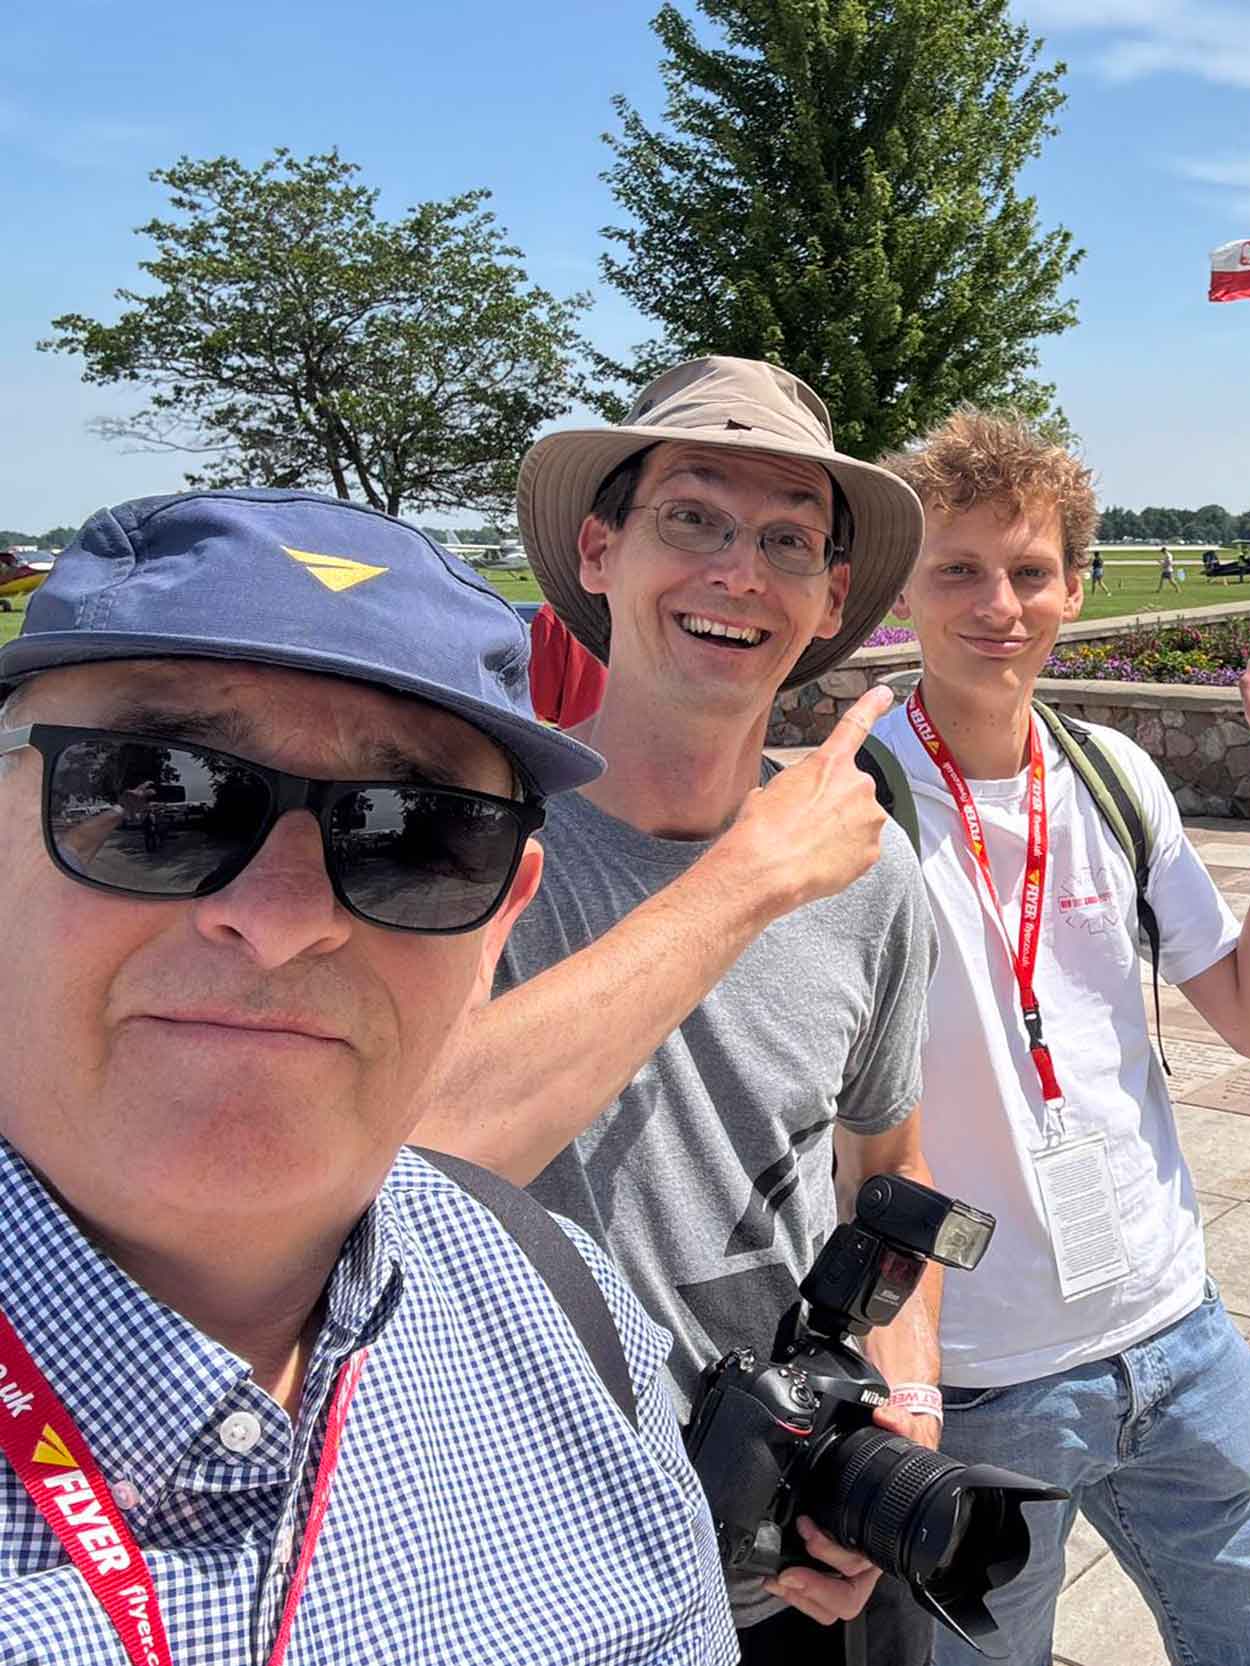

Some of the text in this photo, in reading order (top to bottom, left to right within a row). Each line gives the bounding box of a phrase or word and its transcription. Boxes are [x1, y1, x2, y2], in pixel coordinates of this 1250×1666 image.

[911, 708, 936, 741] FLYER
[963, 805, 981, 841] FLYER
[1024, 882, 1041, 920] FLYER
[44, 1469, 131, 1576] FLYER
